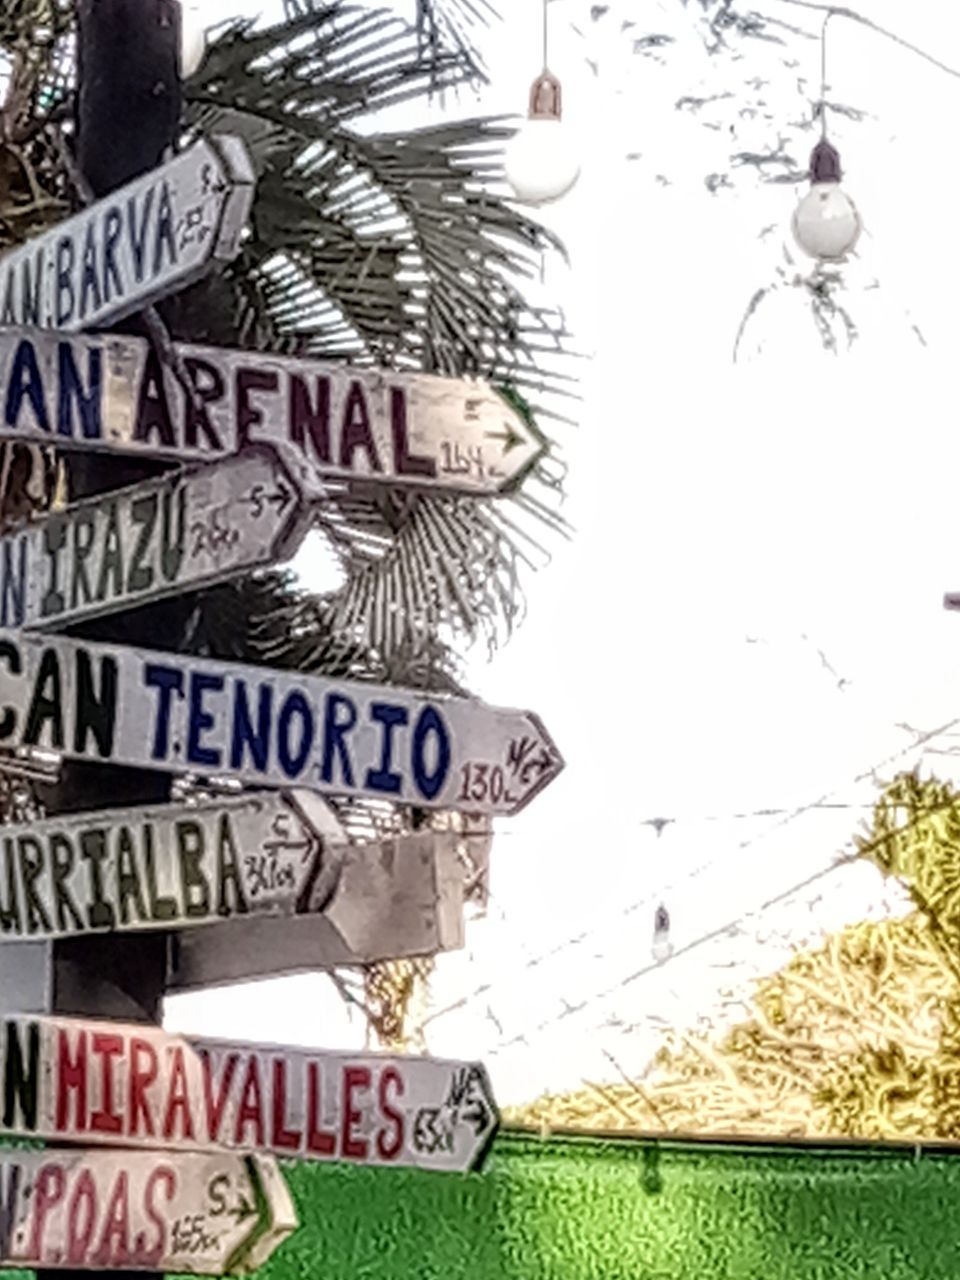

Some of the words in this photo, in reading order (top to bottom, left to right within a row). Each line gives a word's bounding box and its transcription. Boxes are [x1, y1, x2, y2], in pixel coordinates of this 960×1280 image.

[55, 178, 178, 328] BARVA
[132, 345, 437, 478] ARENAL
[40, 480, 187, 616] IRAZU
[145, 669, 451, 800] TENORIO
[457, 761, 503, 804] 130
[55, 1029, 405, 1161] MIRAVALLES
[33, 1163, 177, 1268] POAS
[208, 1174, 231, 1216] S
